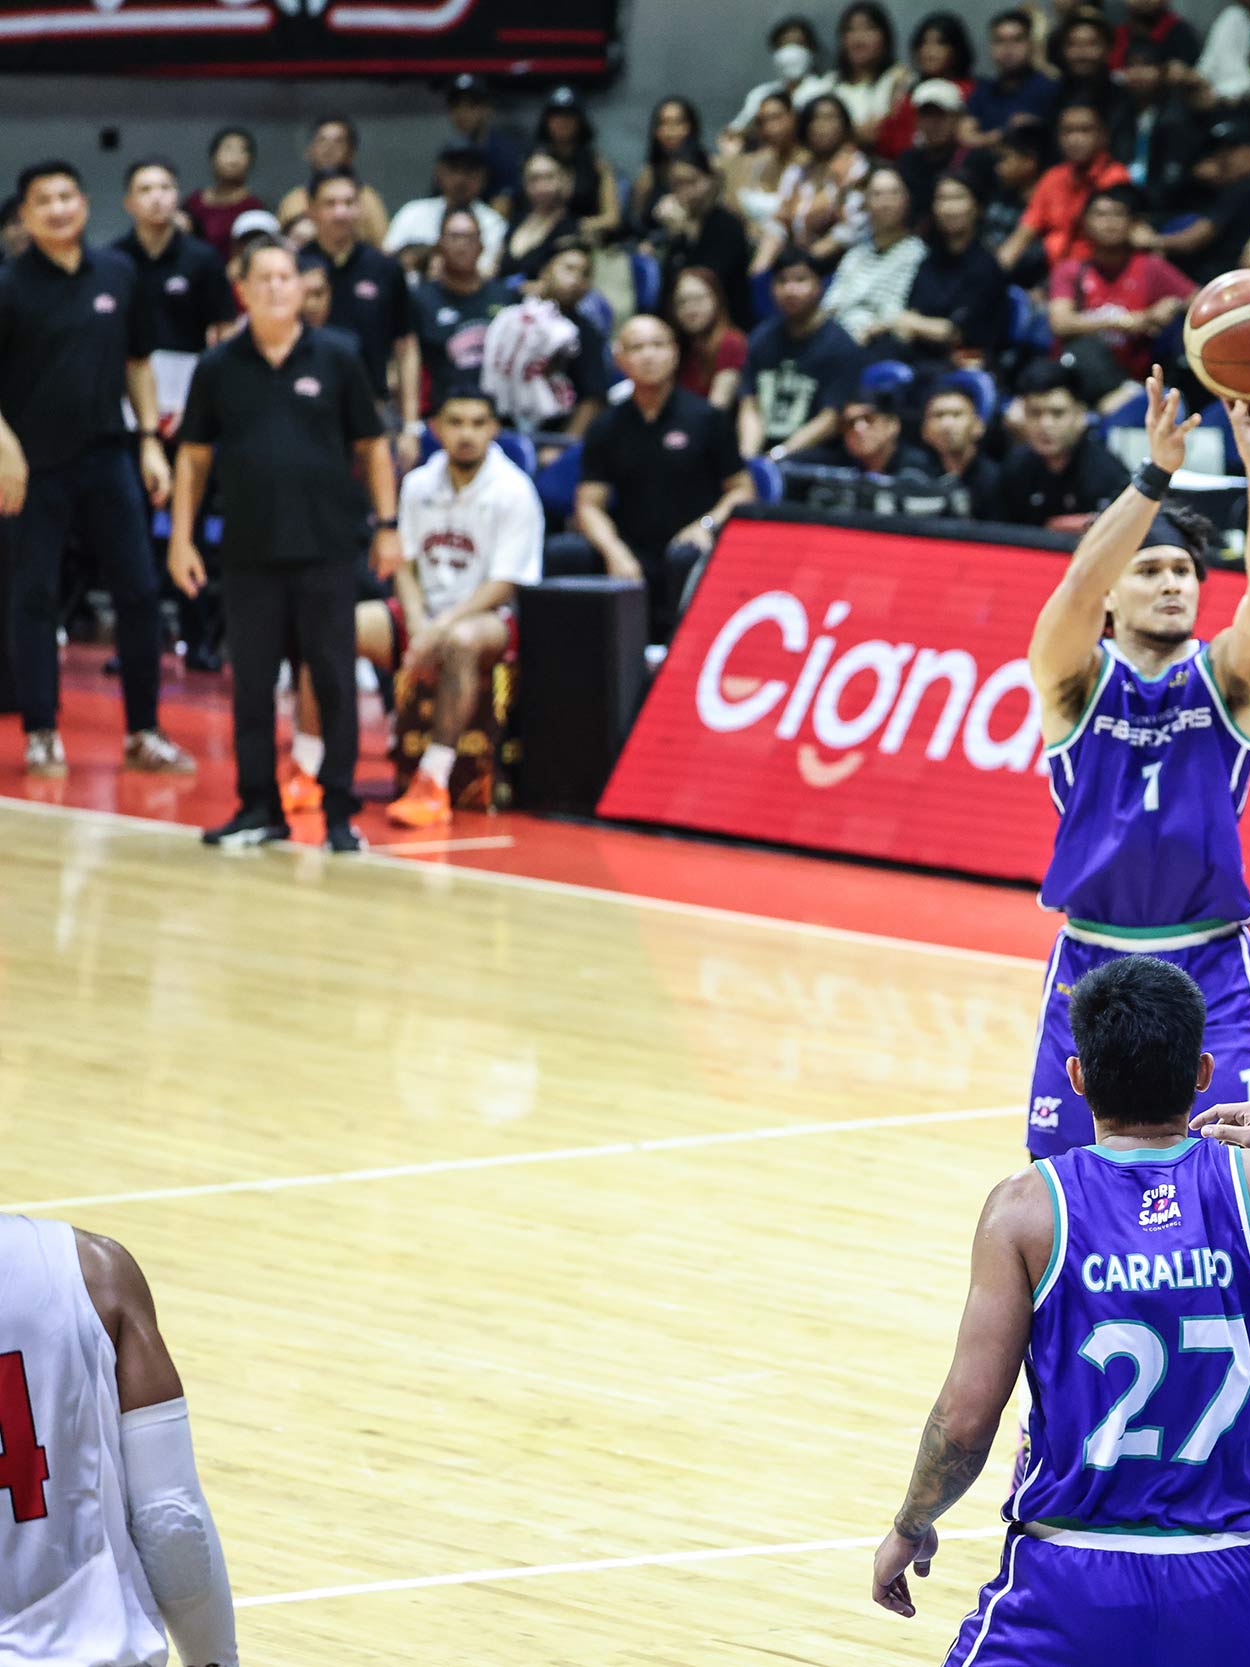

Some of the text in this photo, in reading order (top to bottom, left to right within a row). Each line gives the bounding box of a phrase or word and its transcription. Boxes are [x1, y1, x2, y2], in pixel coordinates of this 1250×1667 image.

[697, 591, 1049, 787] Cigna
[1141, 760, 1163, 812] 1
[1138, 1201, 1182, 1226] SAWA
[1141, 1184, 1177, 1208] SURF
